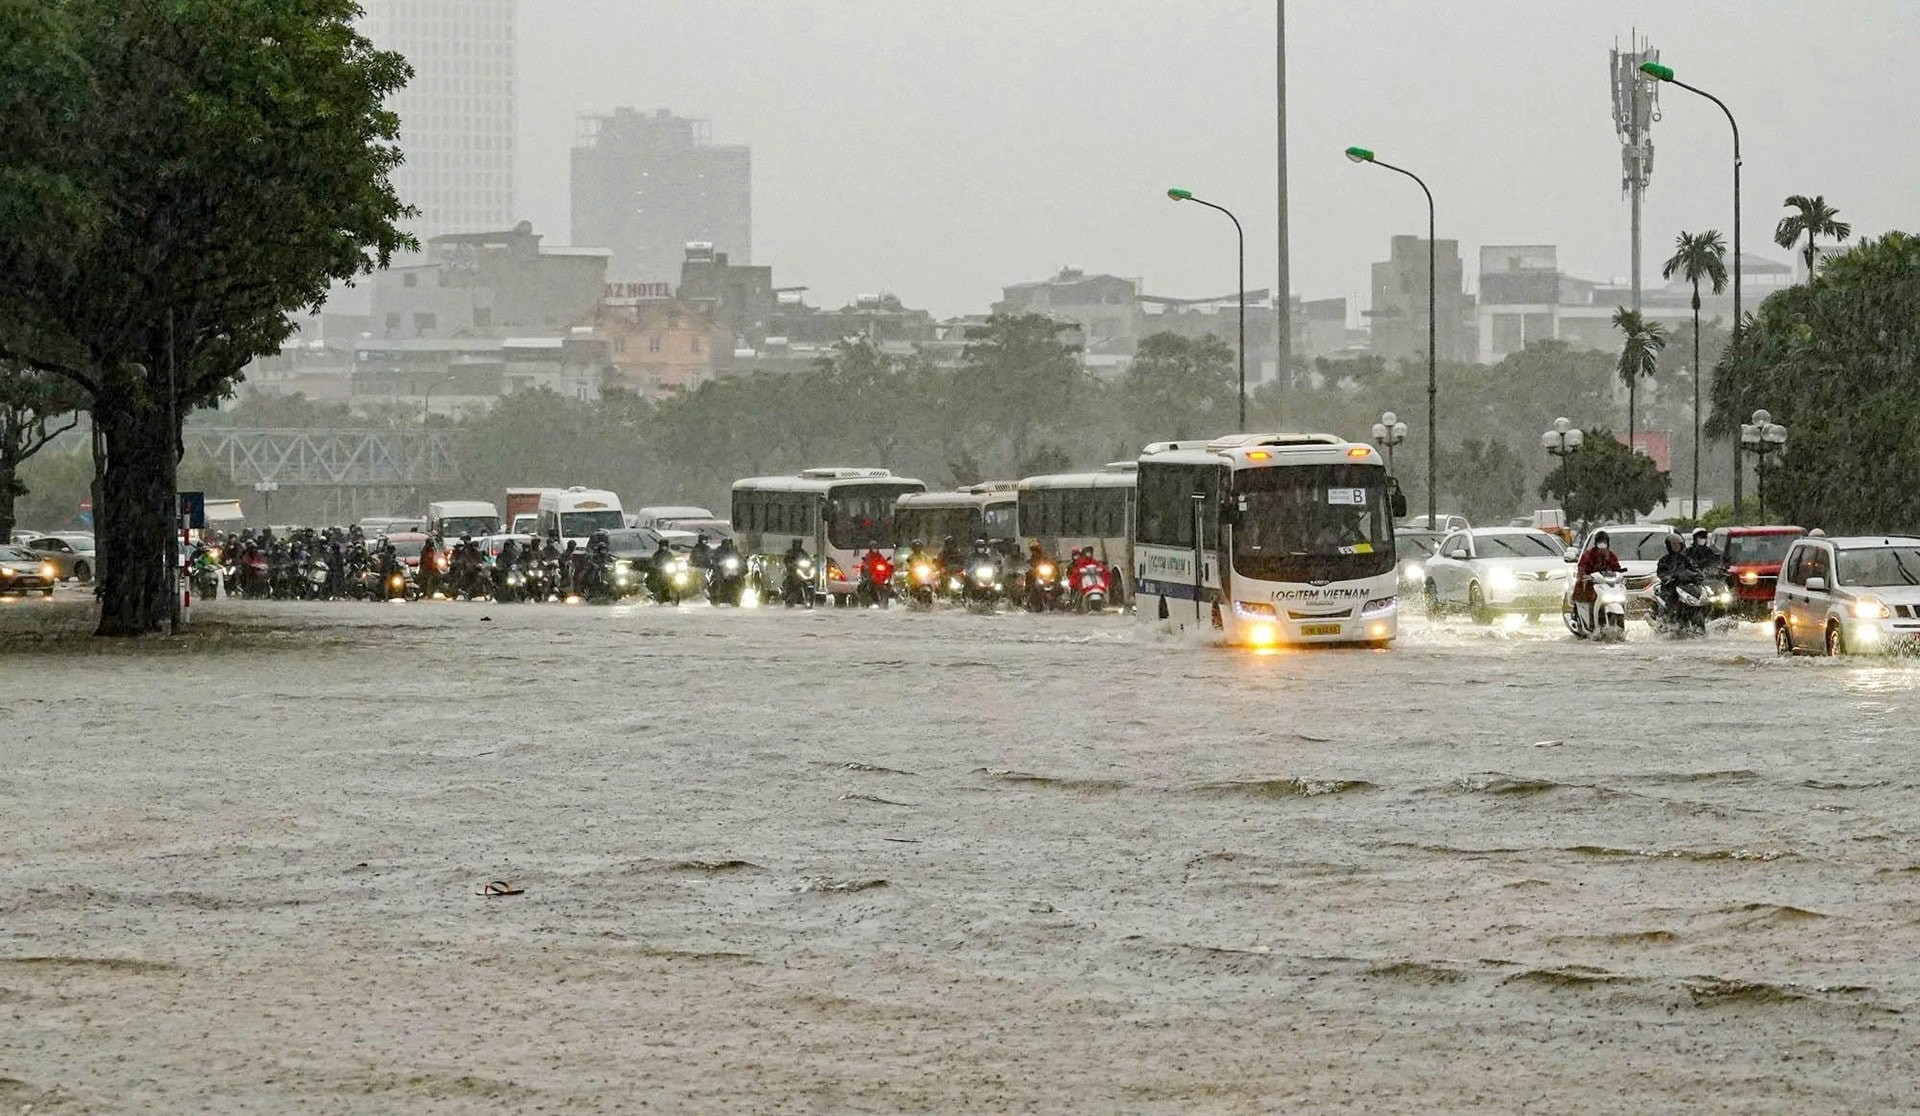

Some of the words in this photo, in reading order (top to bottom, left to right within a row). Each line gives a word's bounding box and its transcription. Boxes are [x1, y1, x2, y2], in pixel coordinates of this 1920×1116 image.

[604, 283, 624, 298] AZ
[627, 283, 669, 298] HOTEL
[1353, 490, 1363, 503] B
[1271, 590, 1320, 601] LOGITEM
[1323, 588, 1370, 600] VIETNAM
